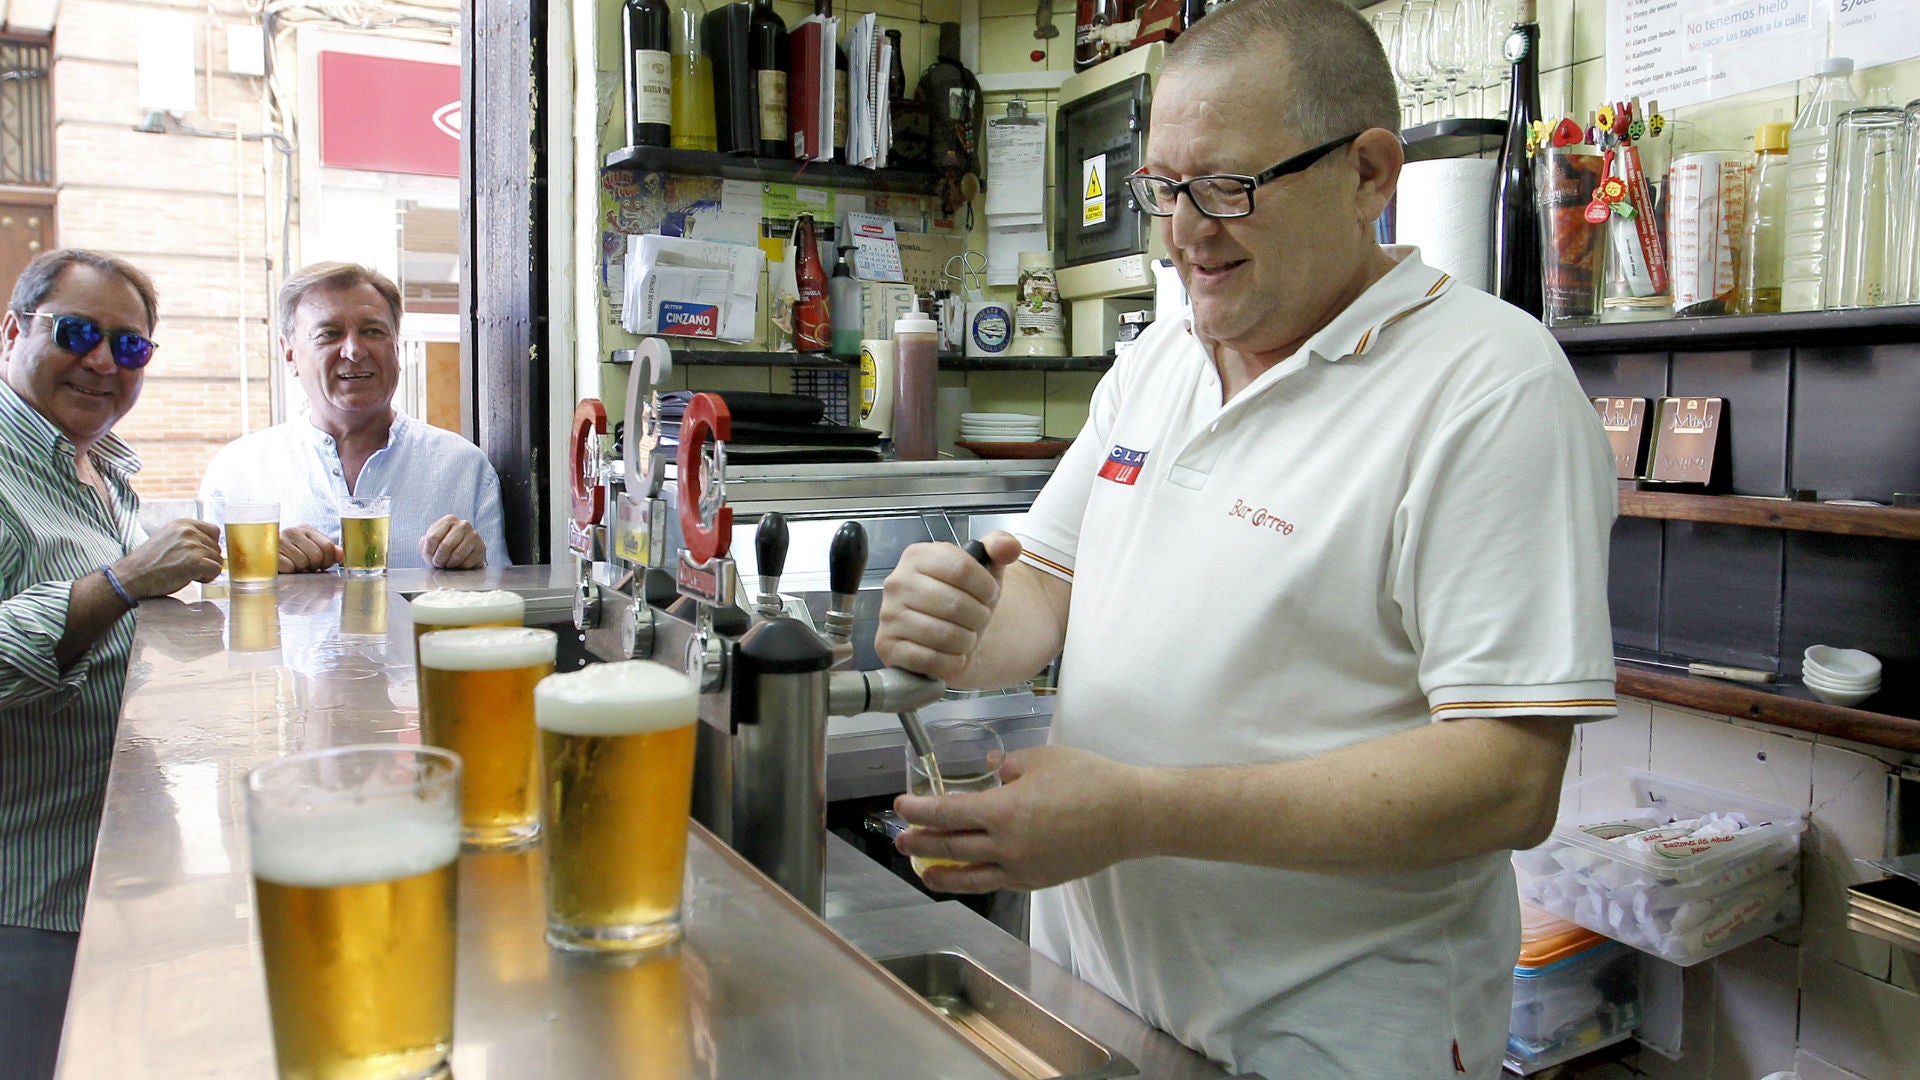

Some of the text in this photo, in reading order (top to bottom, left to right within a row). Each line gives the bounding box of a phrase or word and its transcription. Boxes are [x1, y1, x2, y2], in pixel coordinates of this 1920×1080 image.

[1633, 9, 1648, 19] Tinto
[1649, 7, 1656, 15] de
[1657, 1, 1678, 12] verano
[1687, 0, 1788, 36] No tenemos hielo
[1632, 23, 1648, 33] Clara
[1688, 13, 1807, 53] No sacar las tapas a la calle
[1632, 37, 1646, 46] clara
[1648, 34, 1658, 42] con
[1632, 46, 1662, 60] Kalimocho
[1632, 62, 1655, 74] rebujito
[1652, 71, 1665, 81] tipo
[1665, 69, 1673, 78] de
[1673, 63, 1698, 76] cubatas
[1656, 85, 1669, 95] otro
[1669, 81, 1682, 92] tipo
[1683, 78, 1691, 87] de
[666, 312, 710, 326] CINZANO
[1669, 411, 1713, 431] Mini
[1228, 499, 1252, 519] Bar
